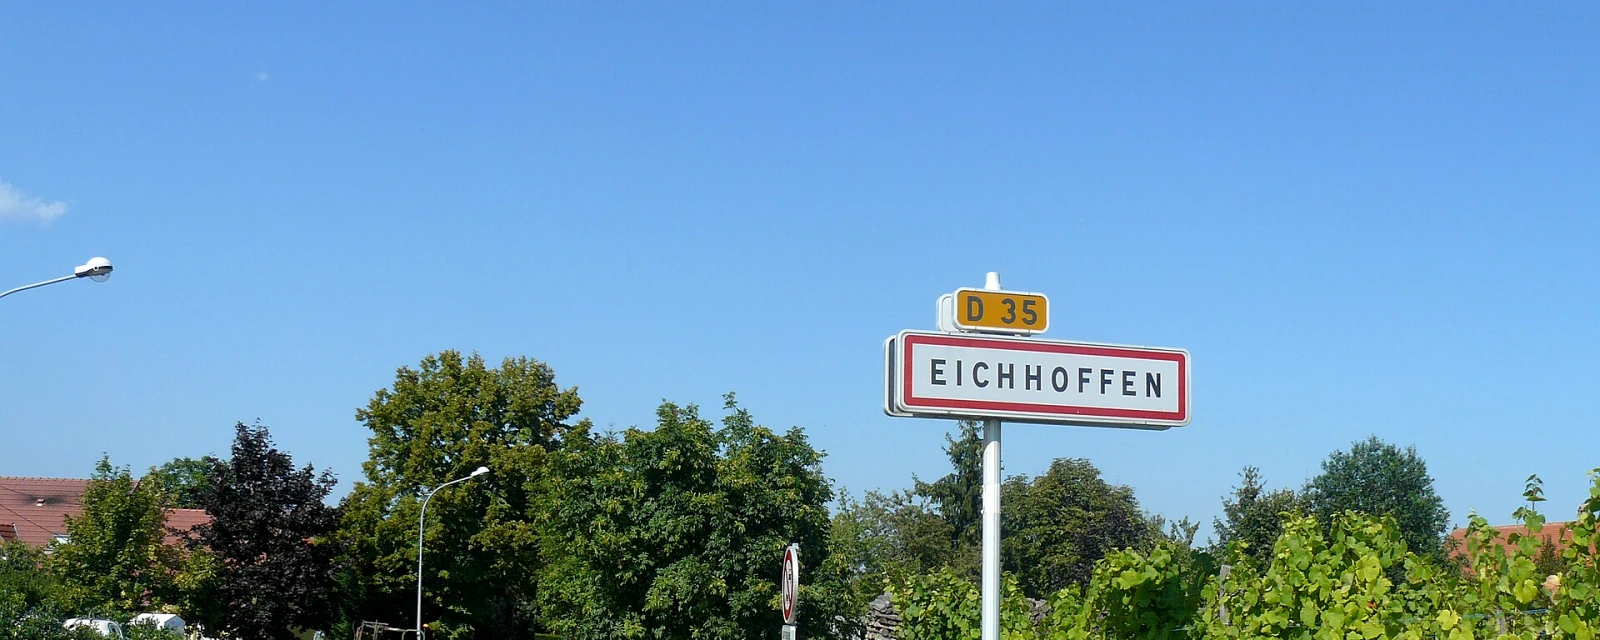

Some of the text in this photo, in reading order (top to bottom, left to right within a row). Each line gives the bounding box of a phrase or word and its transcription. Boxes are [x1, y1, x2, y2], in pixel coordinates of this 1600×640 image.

[966, 295, 1038, 325] D 35
[930, 358, 1162, 398] EICHHOFFEN
